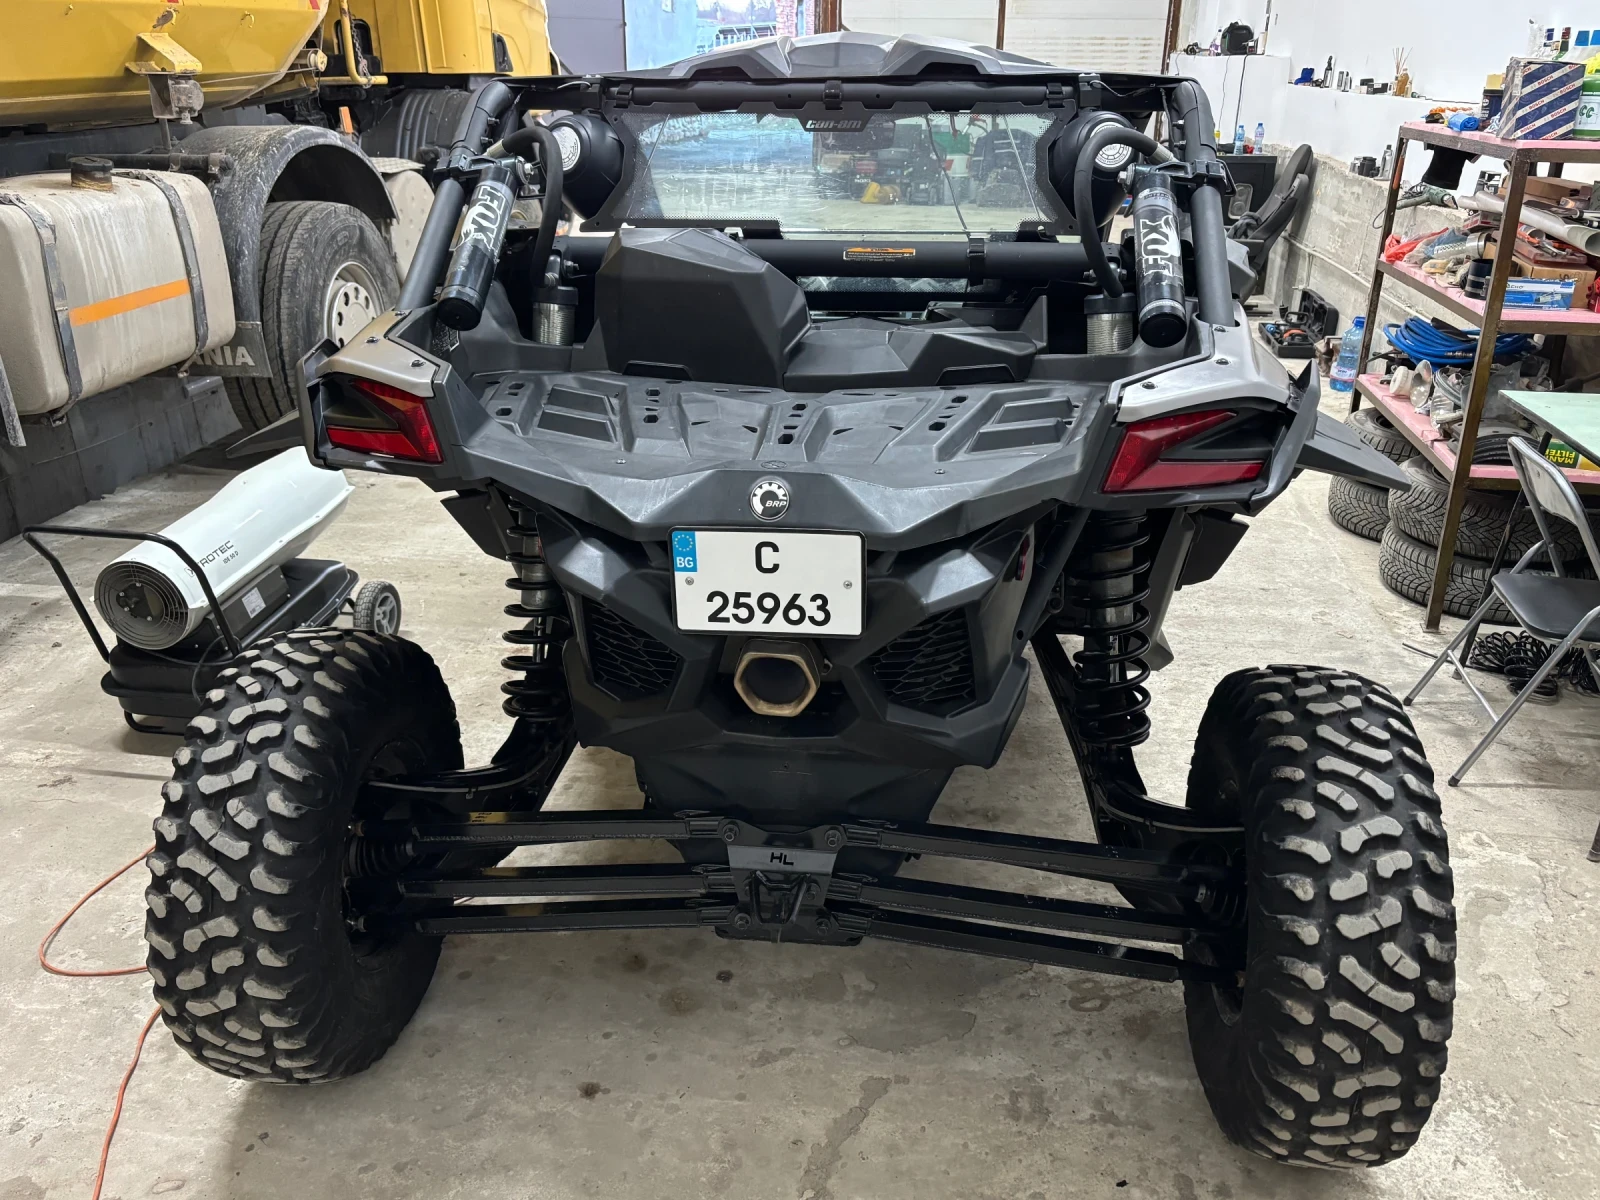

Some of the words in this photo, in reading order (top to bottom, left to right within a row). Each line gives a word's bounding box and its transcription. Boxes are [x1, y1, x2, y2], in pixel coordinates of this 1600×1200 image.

[1537, 75, 1554, 86] BOSCH
[1528, 99, 1545, 110] BOSCH
[1559, 83, 1576, 94] BOSCH
[1520, 123, 1536, 134] BOSCH
[1550, 107, 1567, 118] BOSCH
[462, 186, 505, 250] FOX
[1140, 215, 1180, 277] FOX
[765, 500, 787, 508] BRP
[199, 540, 234, 568] ROTEC
[676, 556, 694, 568] BG
[754, 541, 780, 574] C
[706, 590, 831, 627] 25963
[769, 852, 794, 866] HL
